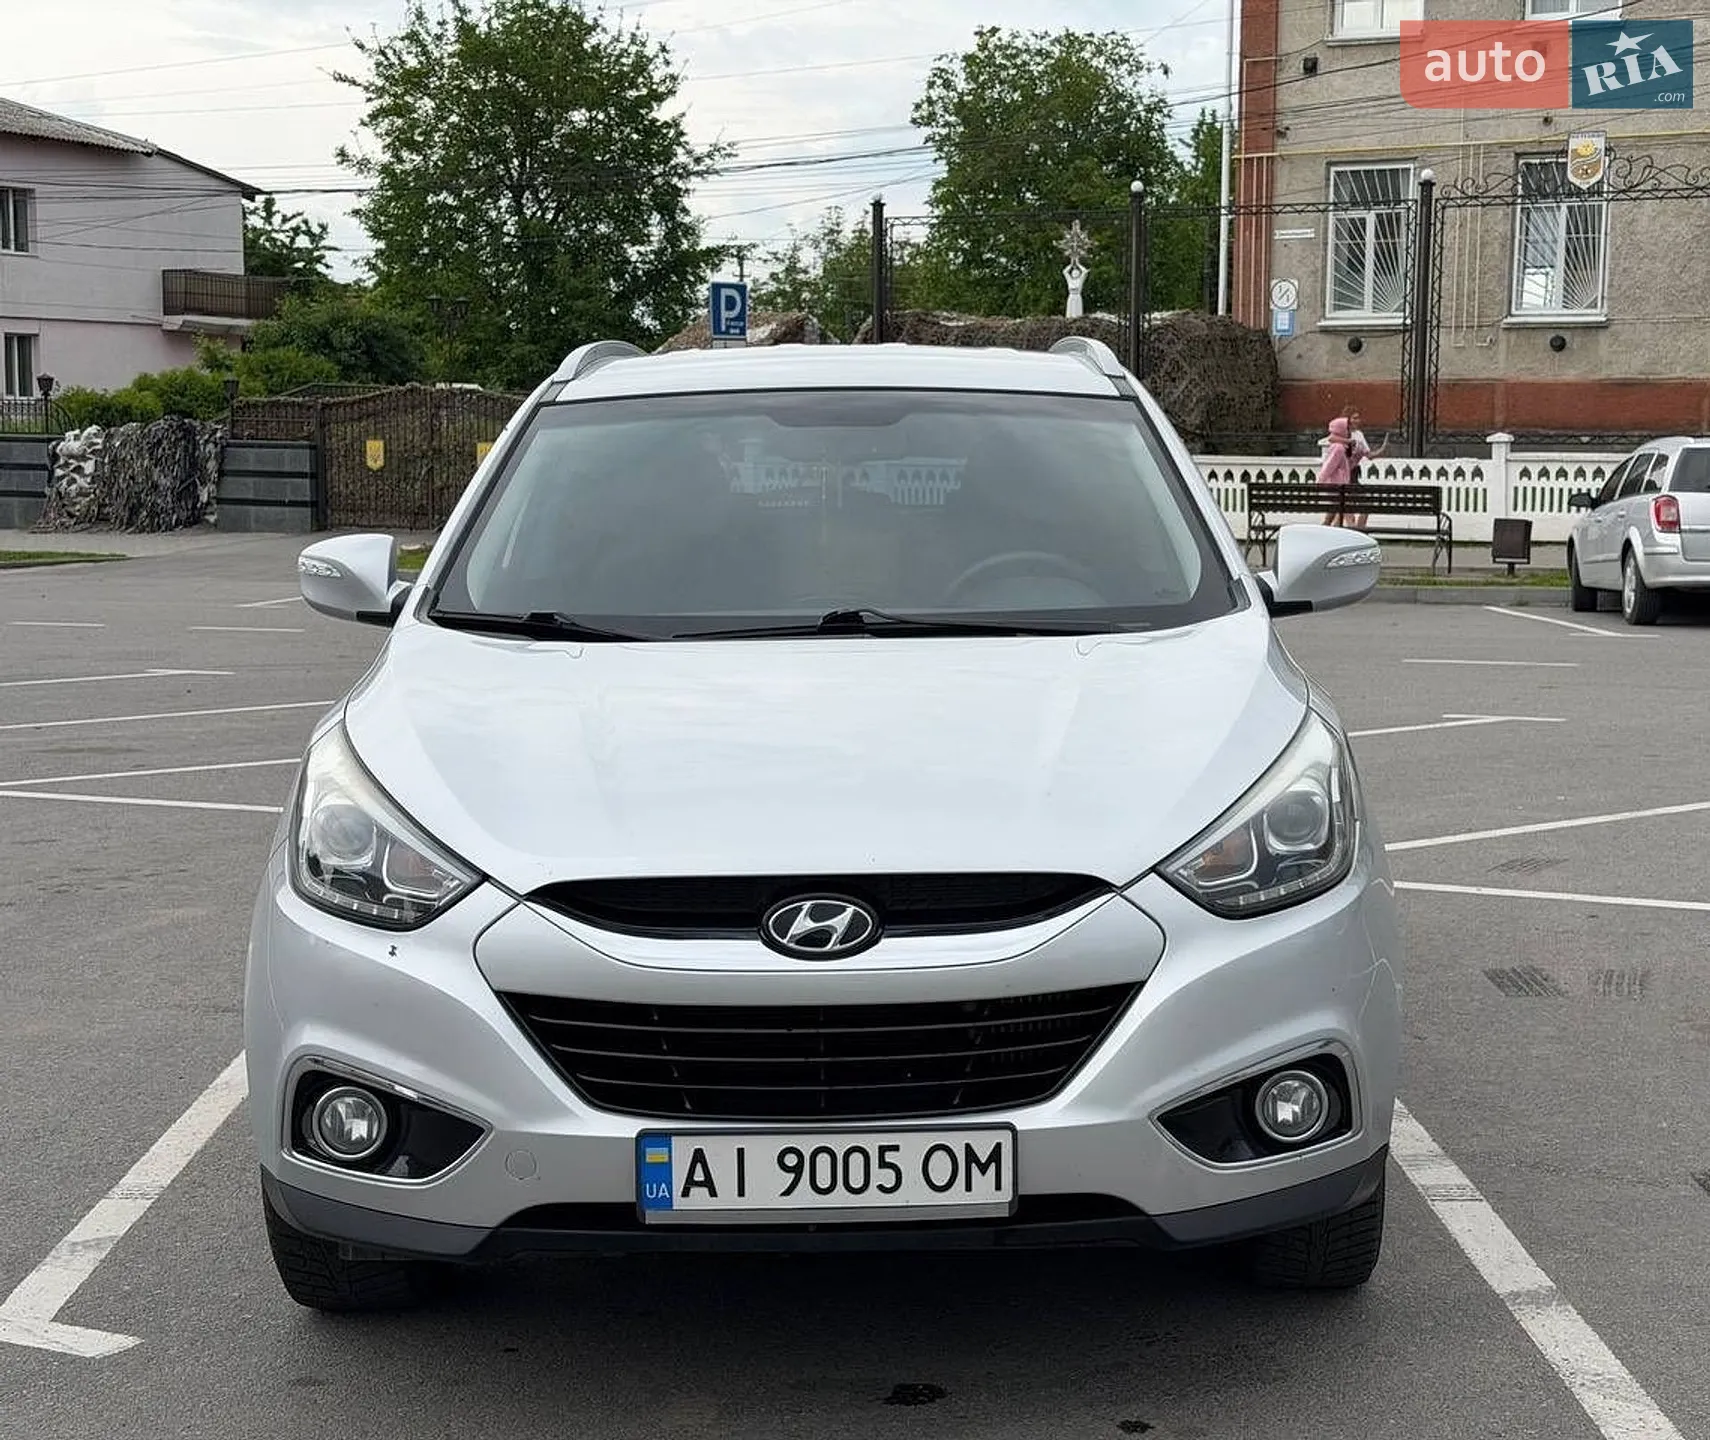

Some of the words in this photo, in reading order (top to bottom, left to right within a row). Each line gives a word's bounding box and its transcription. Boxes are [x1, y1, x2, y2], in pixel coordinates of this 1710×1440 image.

[720, 287, 742, 332] P
[645, 1183, 670, 1199] UA
[680, 1147, 745, 1198] AI
[776, 1144, 903, 1197] 9005
[921, 1141, 1003, 1193] OM
